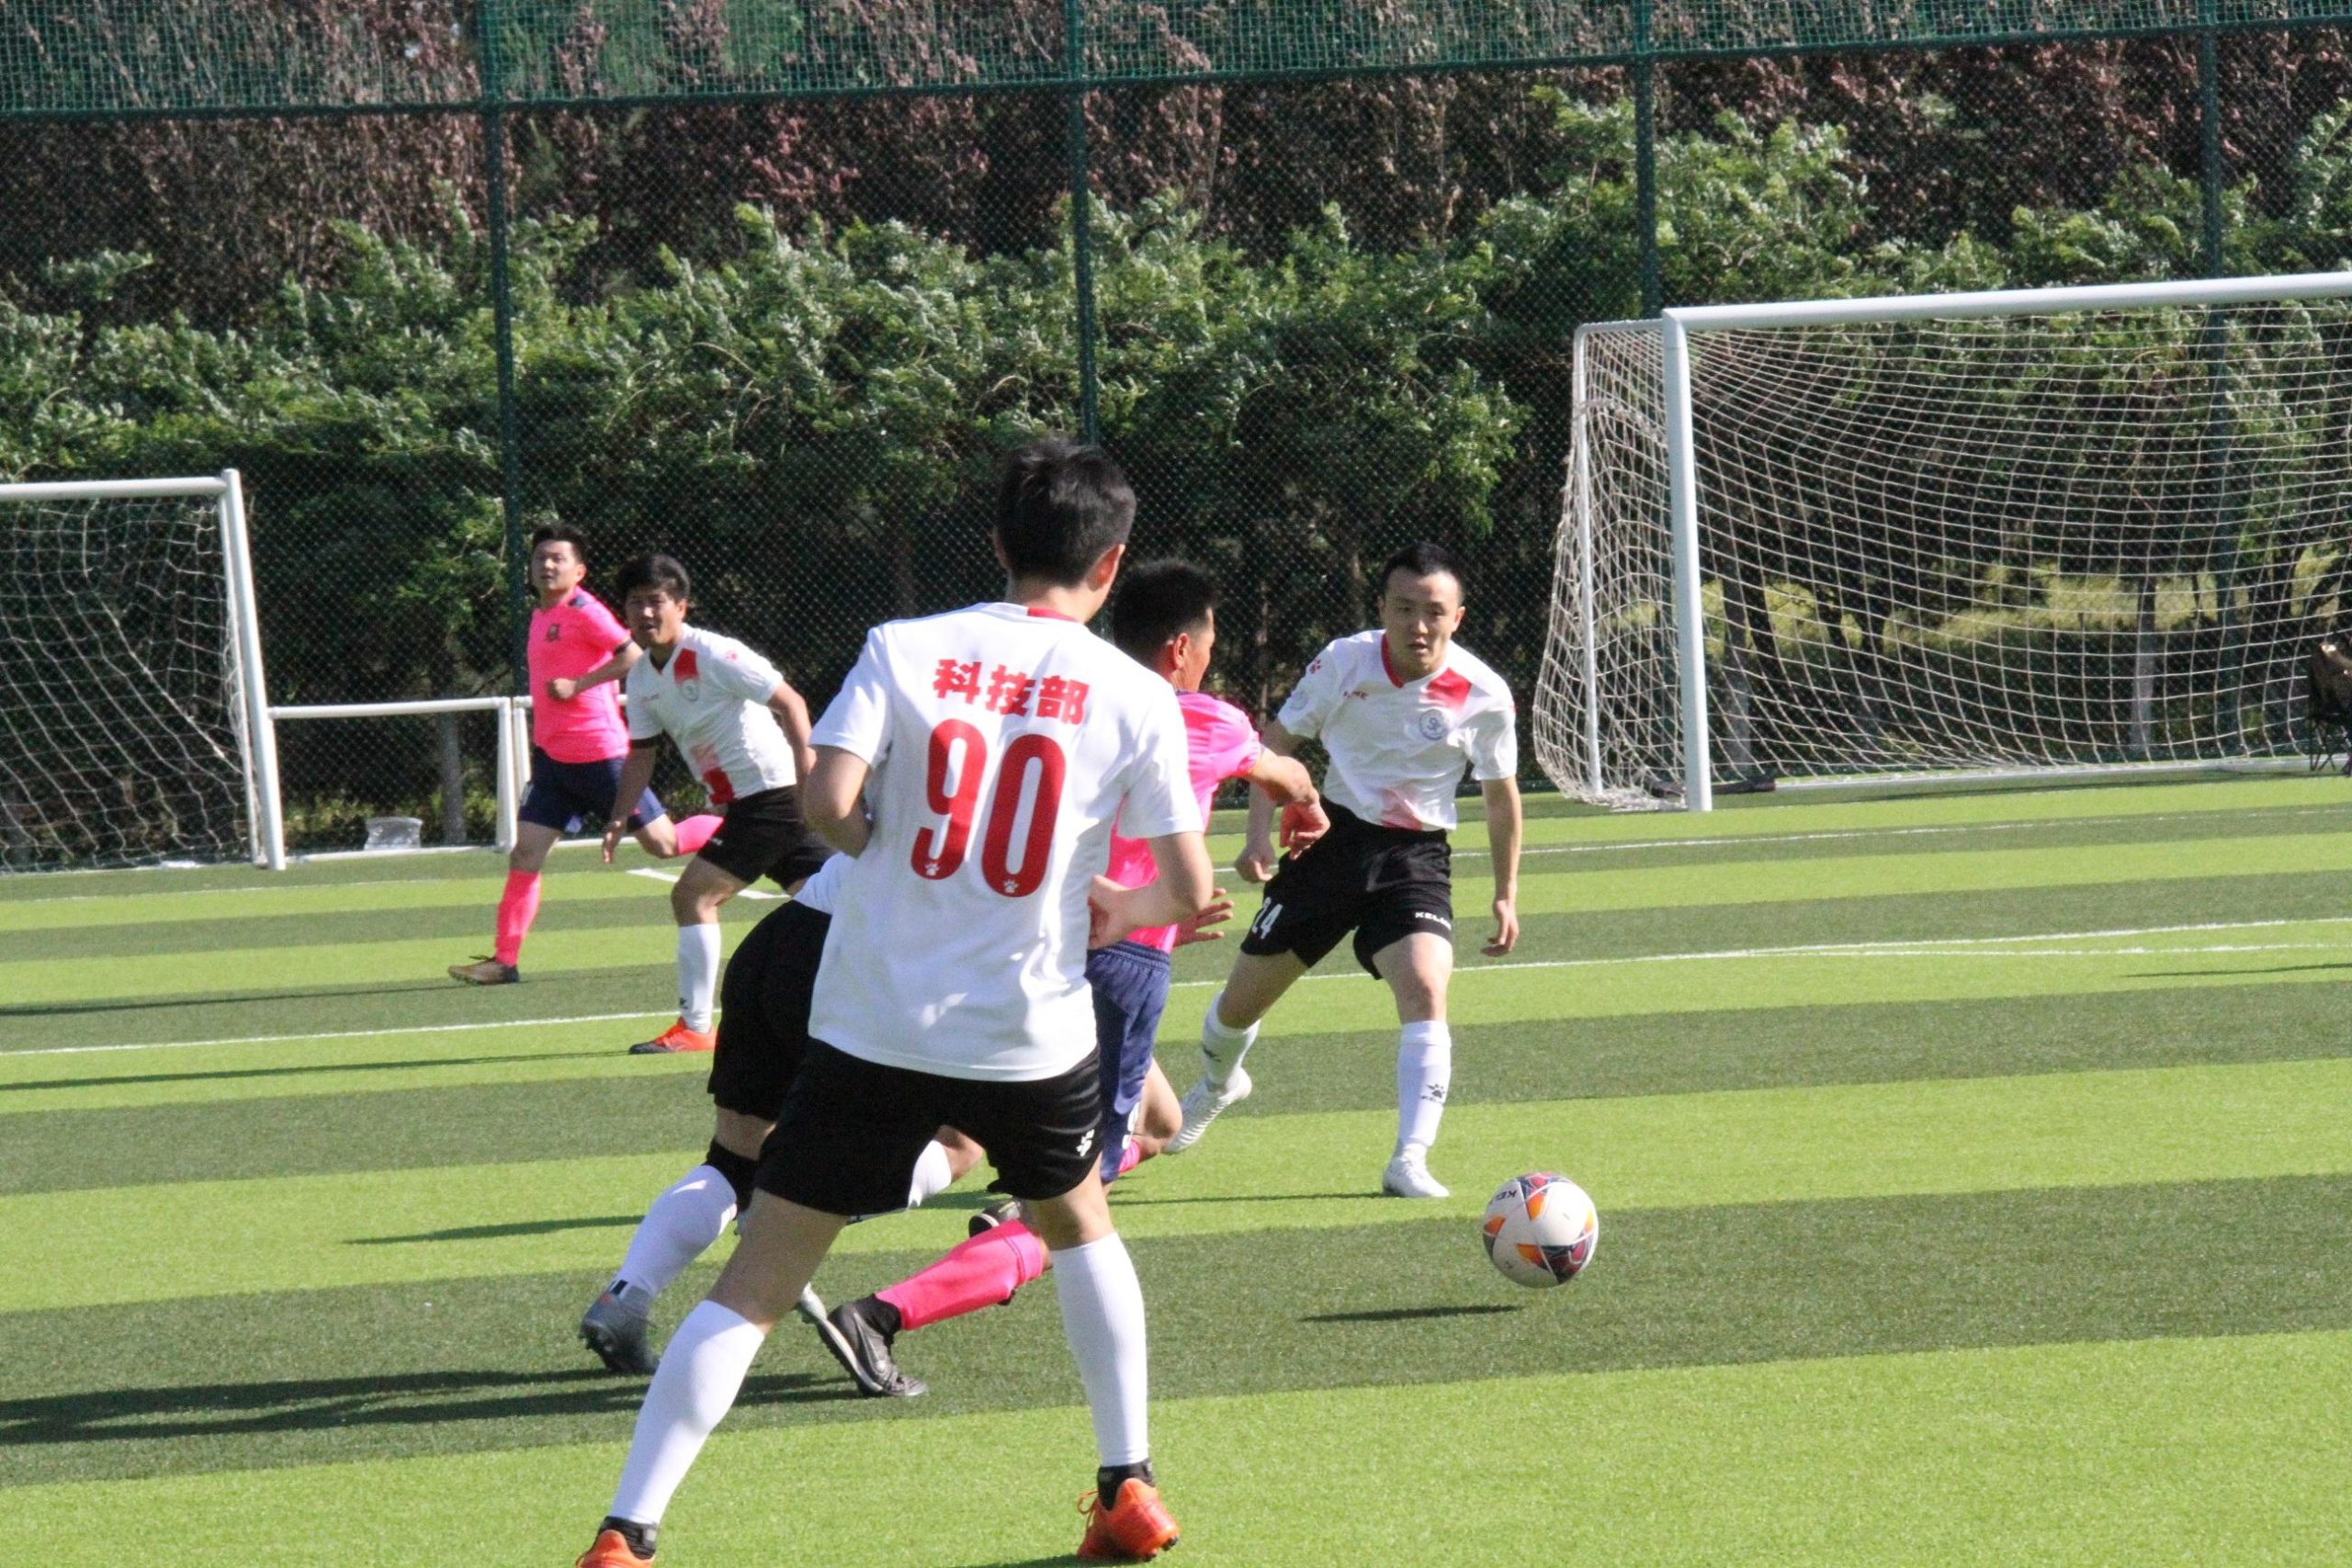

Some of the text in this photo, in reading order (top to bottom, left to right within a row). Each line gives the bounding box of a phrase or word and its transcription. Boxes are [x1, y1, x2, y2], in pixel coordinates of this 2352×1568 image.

[933, 659, 1090, 725] 科技部
[910, 718, 1066, 897] 90
